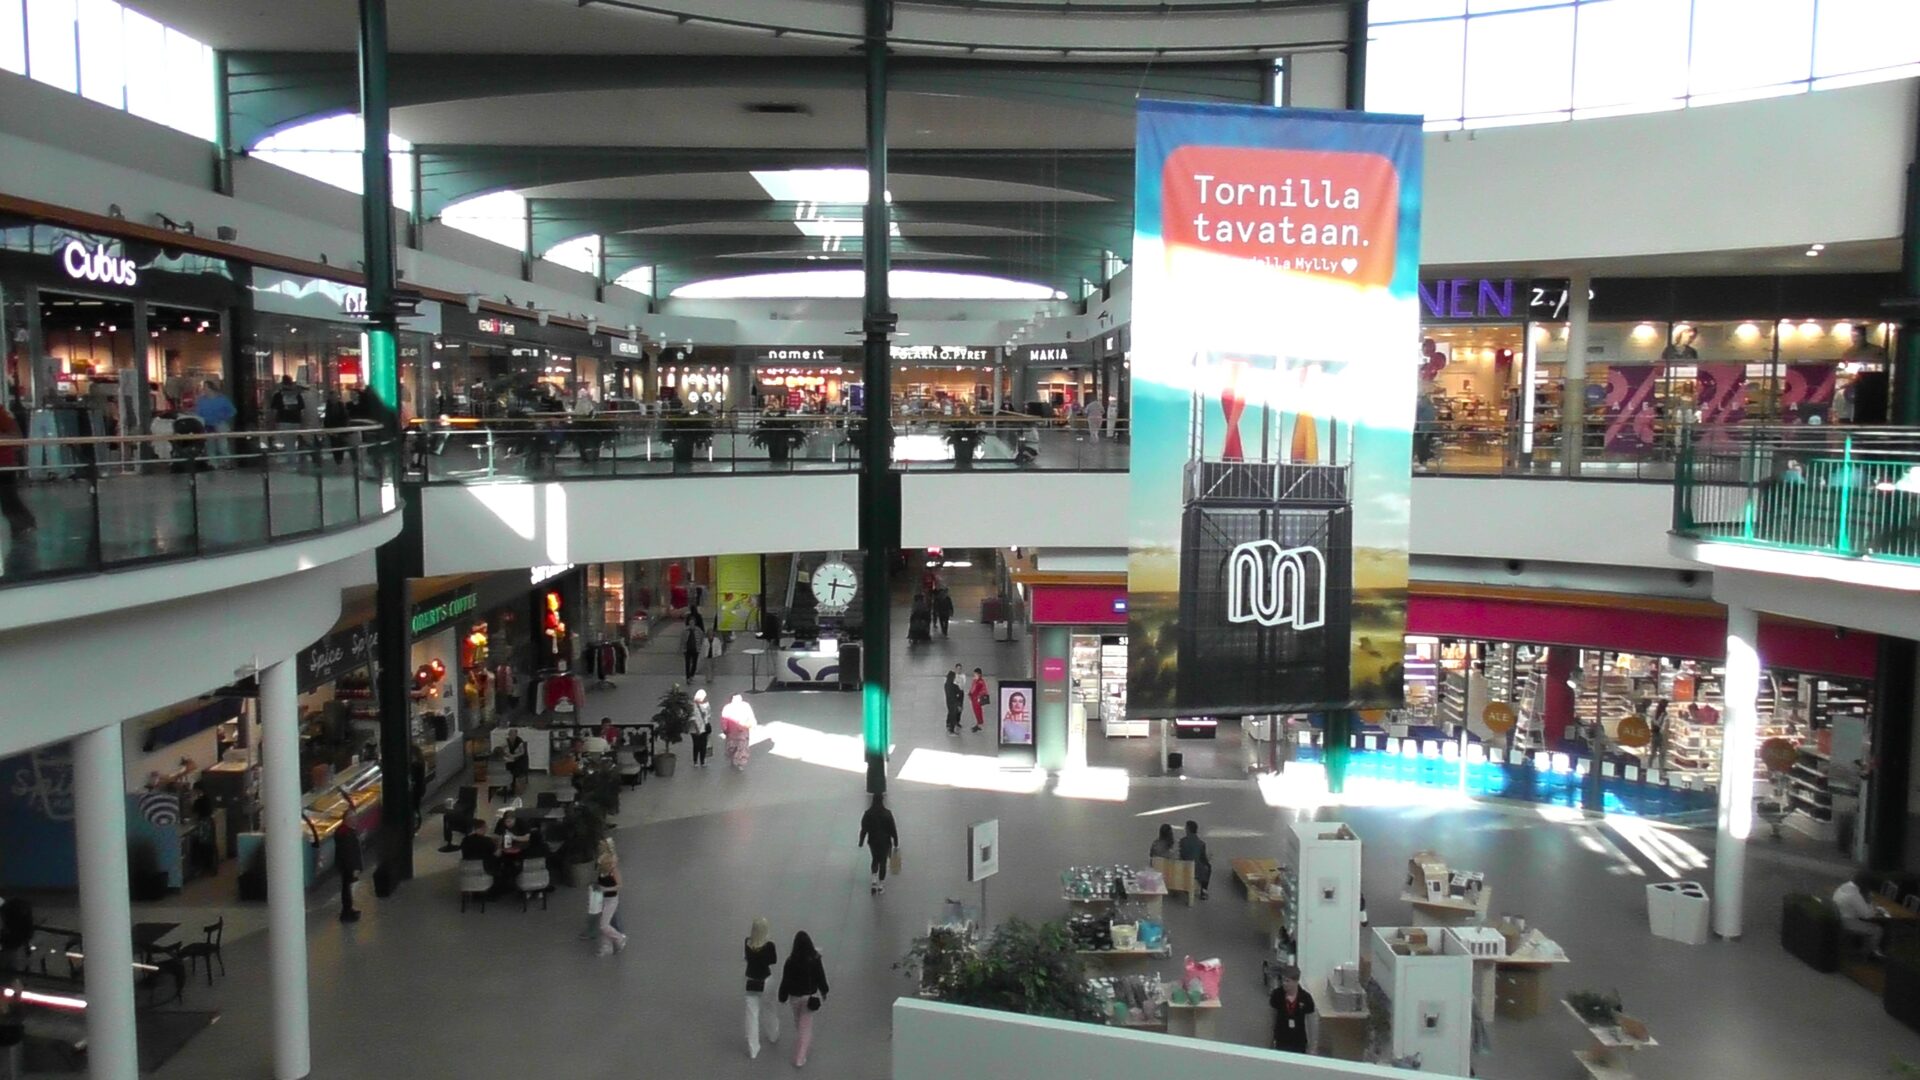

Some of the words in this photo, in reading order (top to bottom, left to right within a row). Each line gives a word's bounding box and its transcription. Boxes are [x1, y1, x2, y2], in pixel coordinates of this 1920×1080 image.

[1194, 175, 1360, 209] Tornilla
[1193, 213, 1369, 247] tavataan.
[64, 240, 137, 286] Cubus
[1295, 257, 1338, 274] Mylly
[953, 349, 987, 360] PYRET
[1030, 348, 1068, 361] MAKIA
[1488, 712, 1509, 722] ALE
[1623, 727, 1646, 737] ALE
